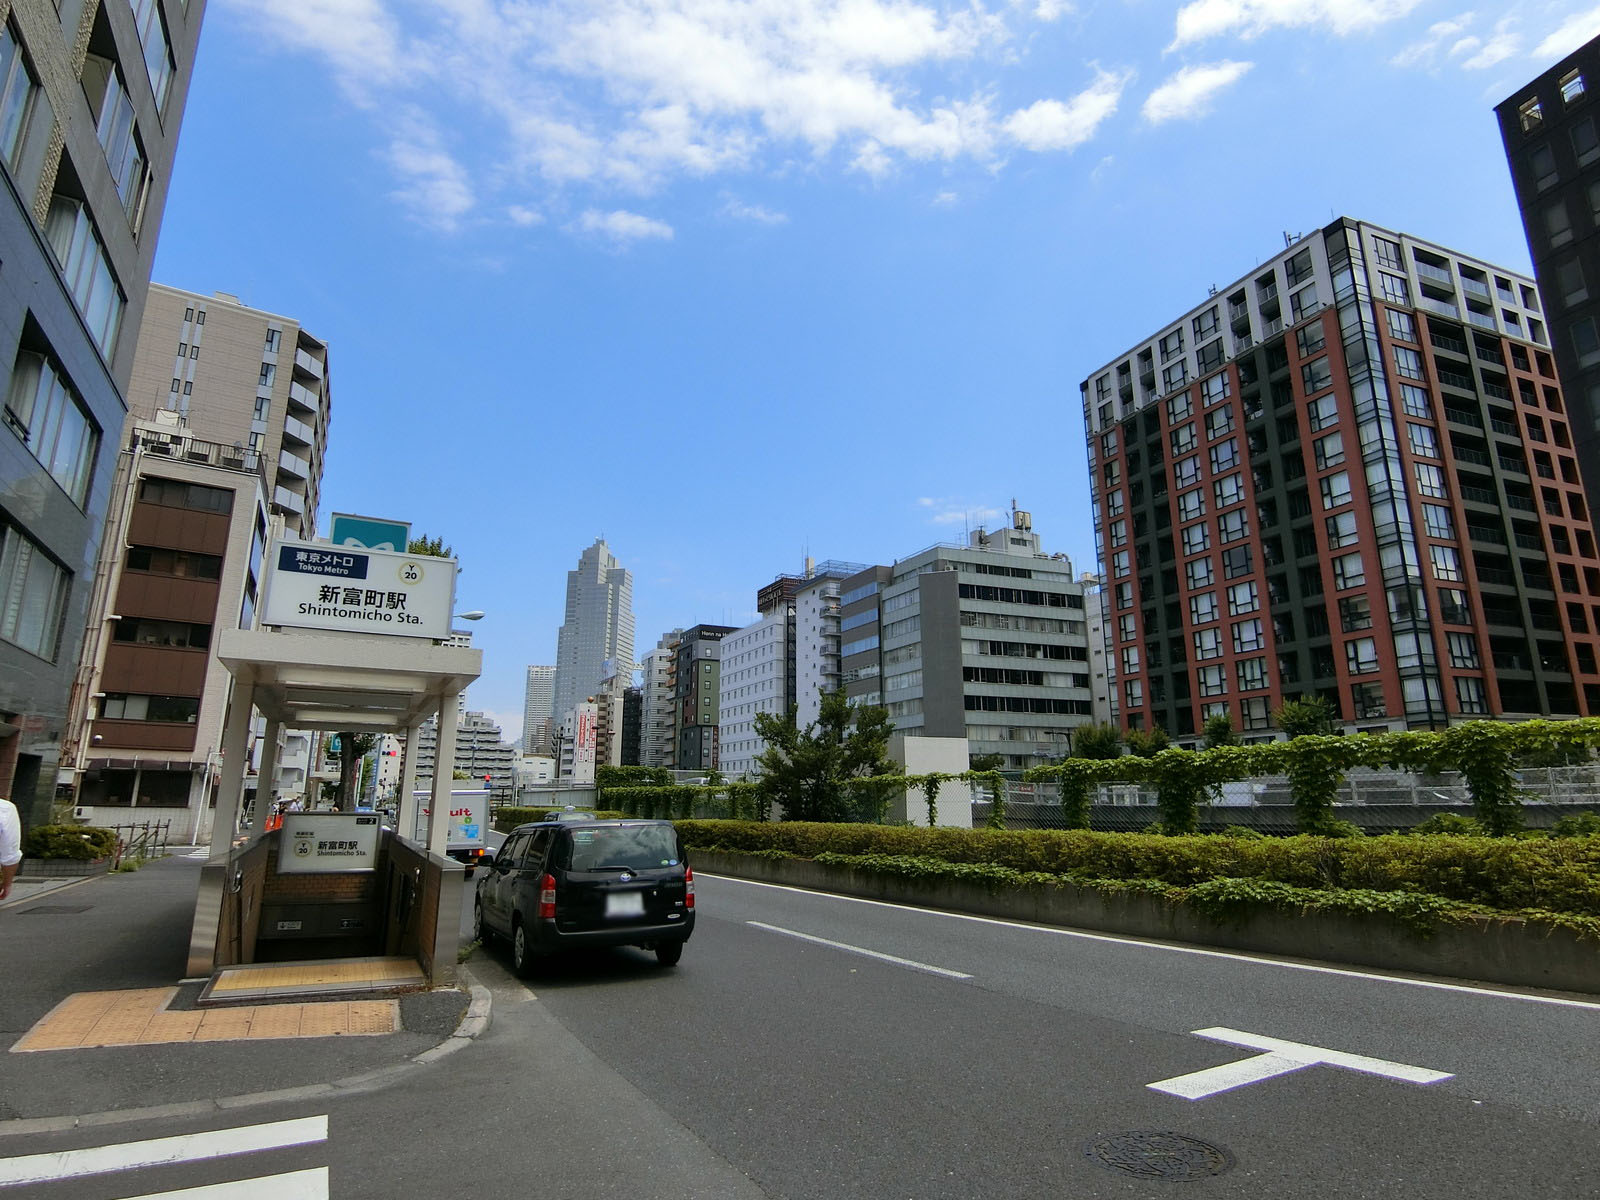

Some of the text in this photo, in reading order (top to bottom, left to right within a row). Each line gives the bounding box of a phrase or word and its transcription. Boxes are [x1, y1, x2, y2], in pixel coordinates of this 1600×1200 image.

[295, 551, 354, 567] 東京メトロ
[298, 562, 349, 575] Tokyo Metro
[404, 571, 417, 580] 20
[318, 584, 407, 611] 新富町駅
[298, 603, 424, 625] Shintomicho Sta.
[422, 807, 473, 817] Yult
[317, 841, 358, 850] 新富町駅
